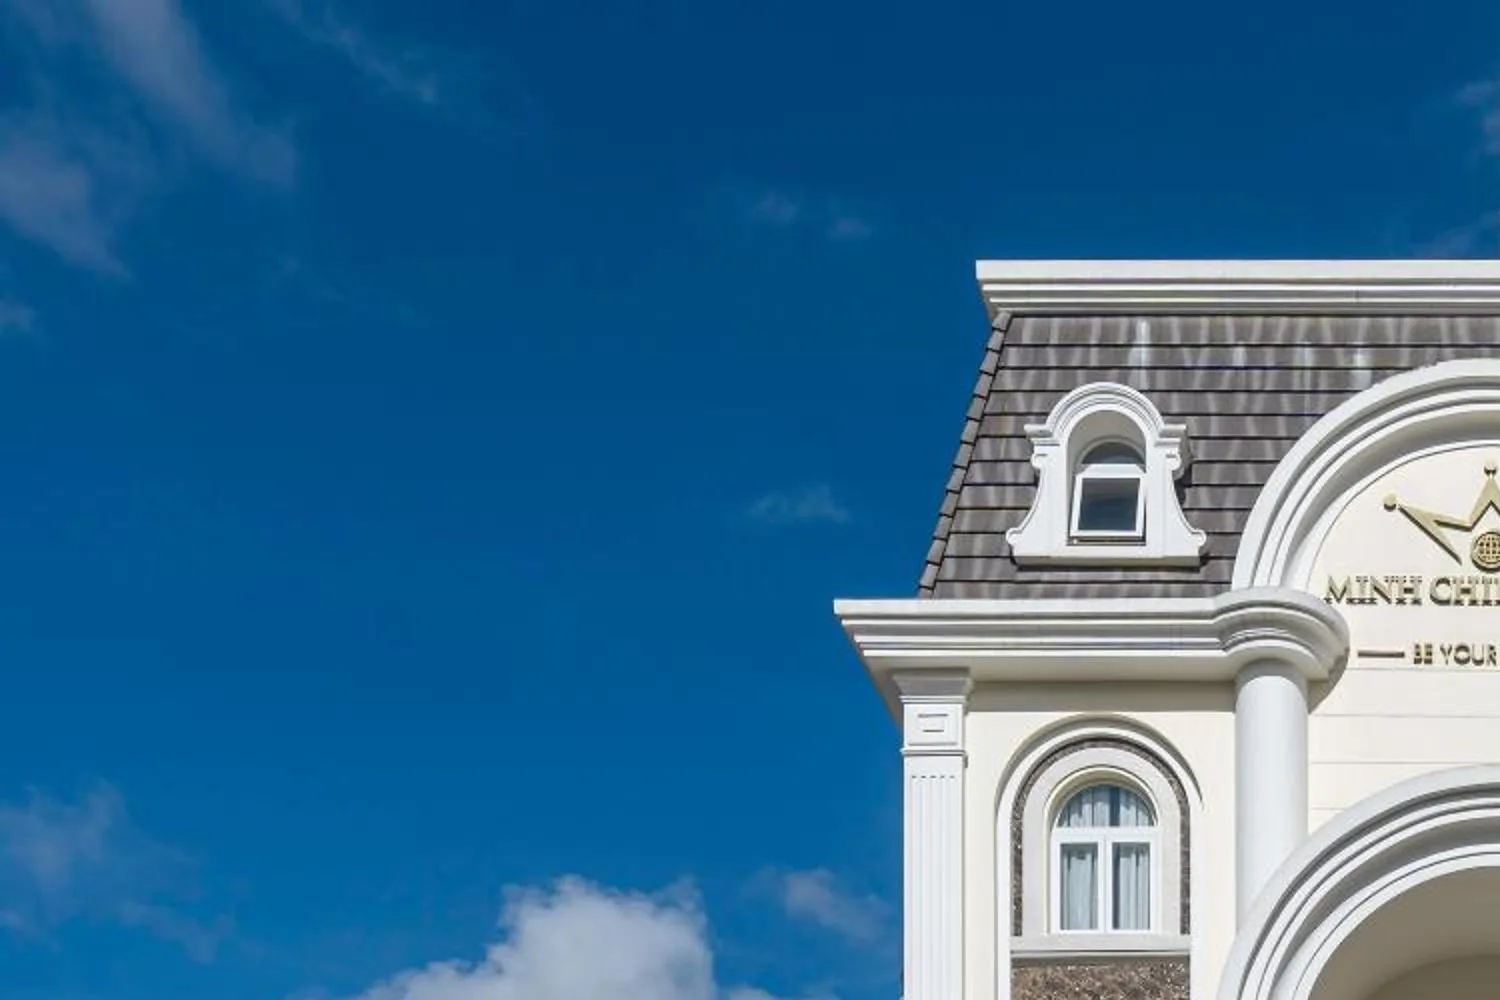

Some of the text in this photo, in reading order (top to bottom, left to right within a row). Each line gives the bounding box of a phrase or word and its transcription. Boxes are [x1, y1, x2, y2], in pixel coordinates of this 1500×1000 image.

[1324, 576, 1423, 605] MINH
[1413, 643, 1433, 665] BE
[1440, 643, 1497, 666] YOUR
